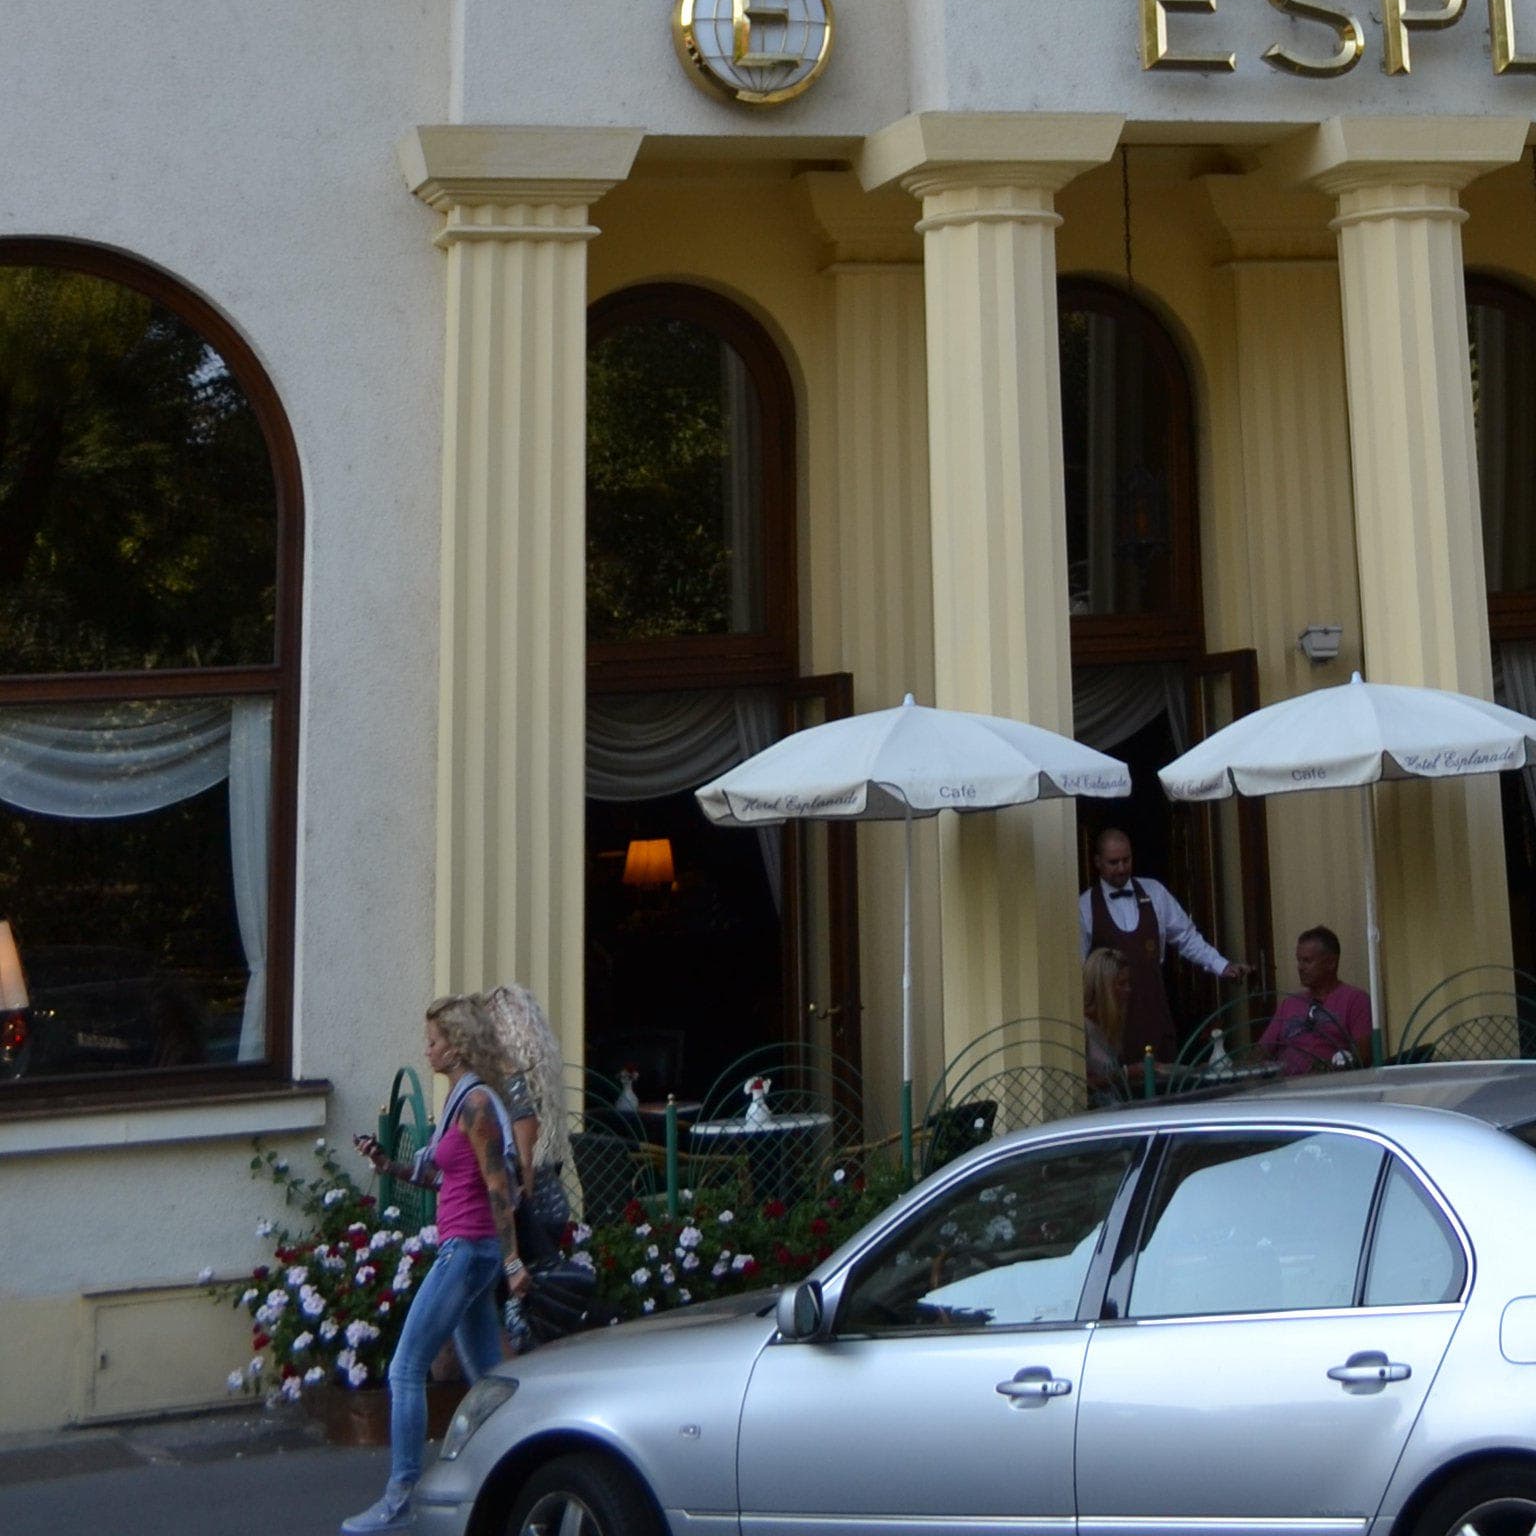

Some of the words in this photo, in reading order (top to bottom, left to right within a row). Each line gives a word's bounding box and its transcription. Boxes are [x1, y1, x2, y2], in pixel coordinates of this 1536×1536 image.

[1443, 746, 1515, 772] Esplanade
[1291, 767, 1327, 782] Café
[939, 784, 977, 800] Café
[742, 795, 782, 813] Hotel
